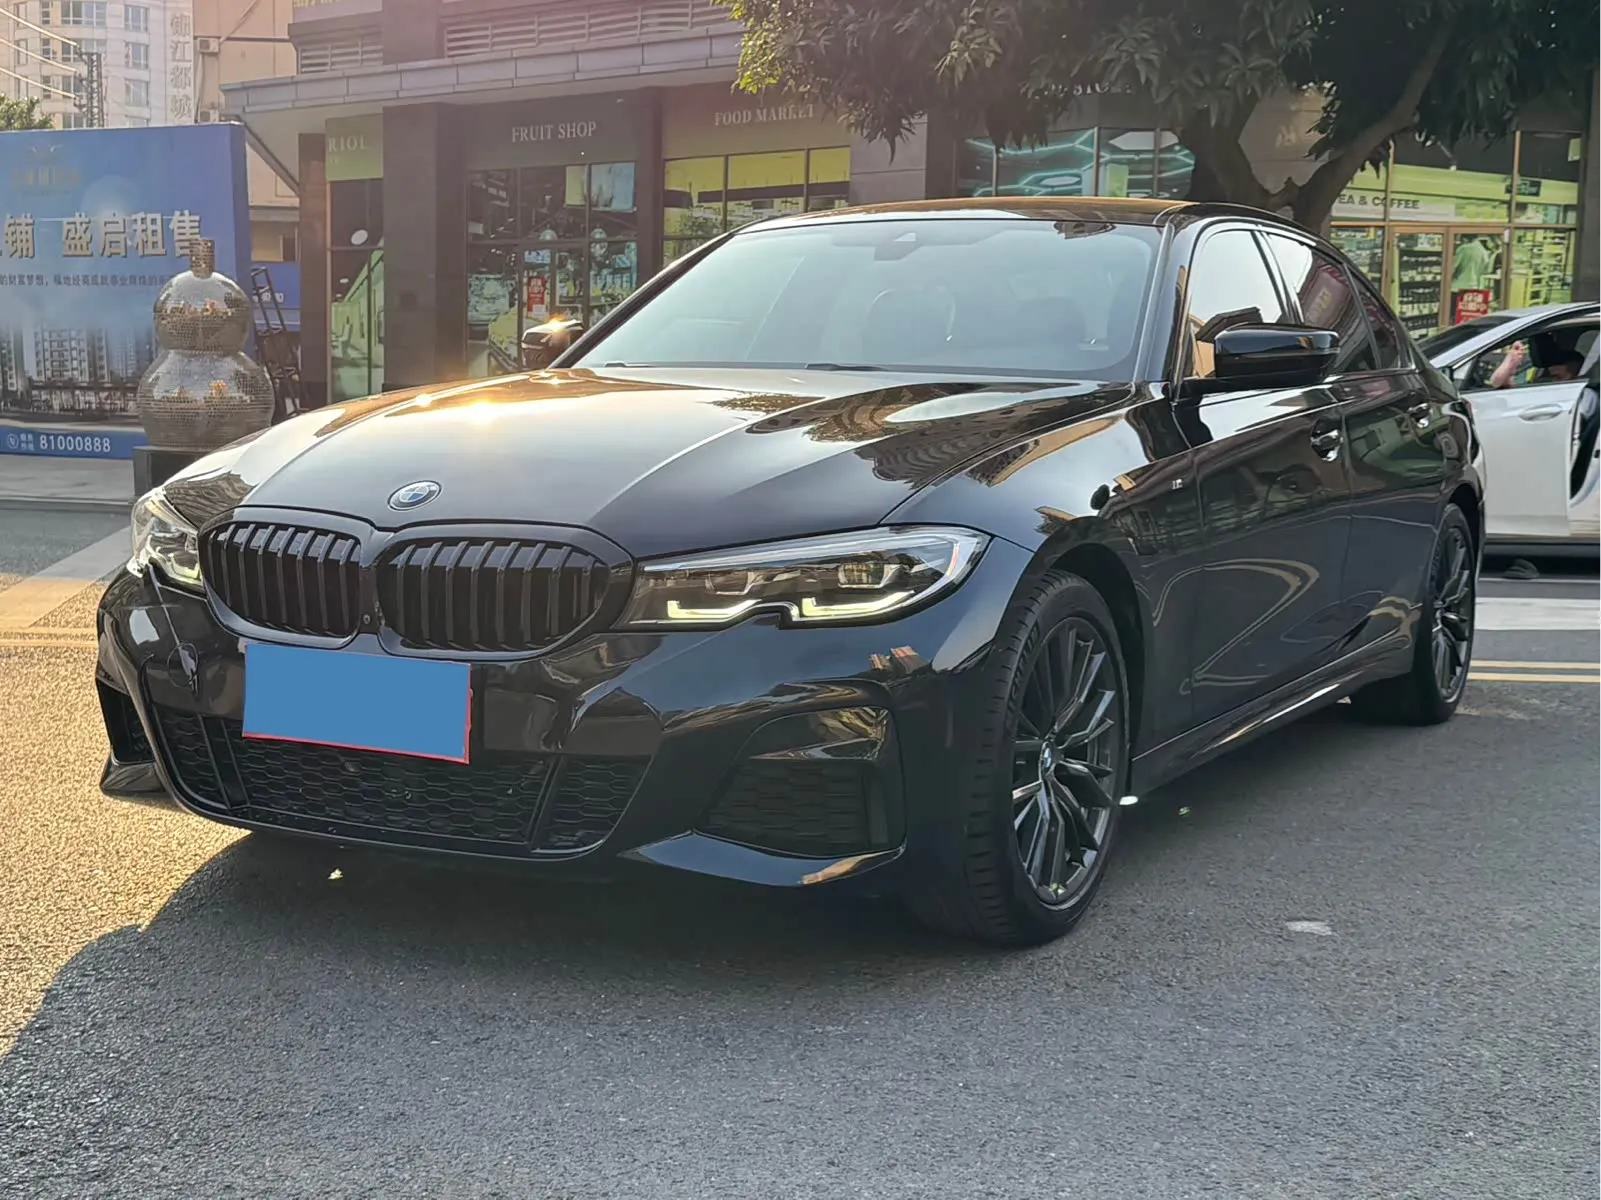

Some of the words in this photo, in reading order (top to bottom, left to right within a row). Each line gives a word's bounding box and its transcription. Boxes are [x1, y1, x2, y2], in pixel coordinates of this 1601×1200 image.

[714, 110, 752, 126] FOOD
[512, 124, 554, 143] FRUIT
[558, 120, 597, 139] SHOP
[1338, 193, 1355, 205] EA
[3, 212, 36, 258] 铺
[62, 210, 201, 258] 盛启租售
[40, 434, 111, 452] 81000888
